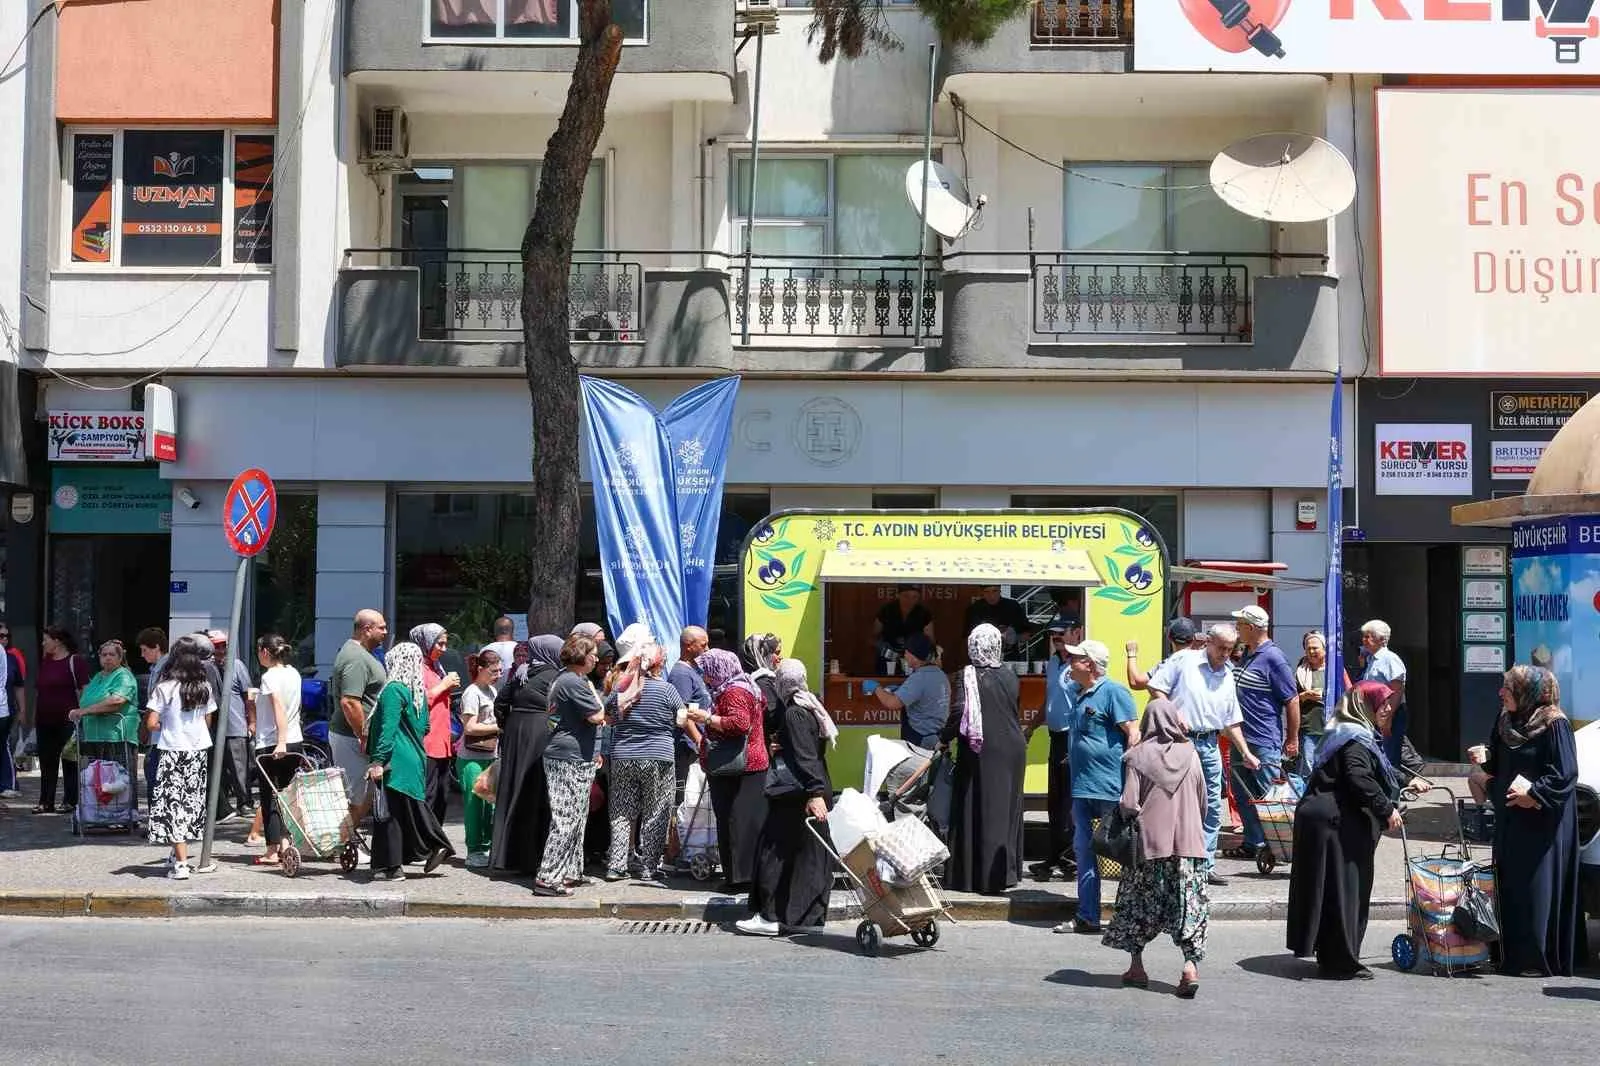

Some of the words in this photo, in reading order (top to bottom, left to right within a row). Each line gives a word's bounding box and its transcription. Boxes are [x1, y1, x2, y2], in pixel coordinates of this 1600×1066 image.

[136, 186, 215, 208] UZMAN
[1467, 173, 1527, 226] En
[138, 224, 162, 233] 0532
[164, 224, 179, 233] 130
[182, 224, 194, 233] 64
[196, 224, 207, 233] 53
[1518, 394, 1581, 409] METAFİZİK
[49, 412, 92, 429] KİCK
[98, 415, 145, 429] BOKS
[1499, 415, 1517, 426] ÖZEL
[1520, 415, 1553, 427] ÖĞRETİM
[1556, 416, 1570, 426] KU
[1380, 441, 1467, 463] KEMER
[1495, 447, 1546, 456] BRITISHT
[1380, 460, 1417, 470] SÜRÜCÜ
[1435, 461, 1468, 470] KURSU
[844, 523, 868, 537] T.C.
[872, 524, 918, 537] AYDIN
[923, 521, 1017, 541] BÜYÜKŞEHİR
[1022, 522, 1106, 539] BELEDİYESİ
[1513, 522, 1567, 550] BÜYÜKŞEHİR
[1516, 595, 1537, 621] HALK
[1539, 595, 1568, 621] EKMEK
[835, 711, 856, 721] T.C.
[863, 712, 900, 721] AYDIN
